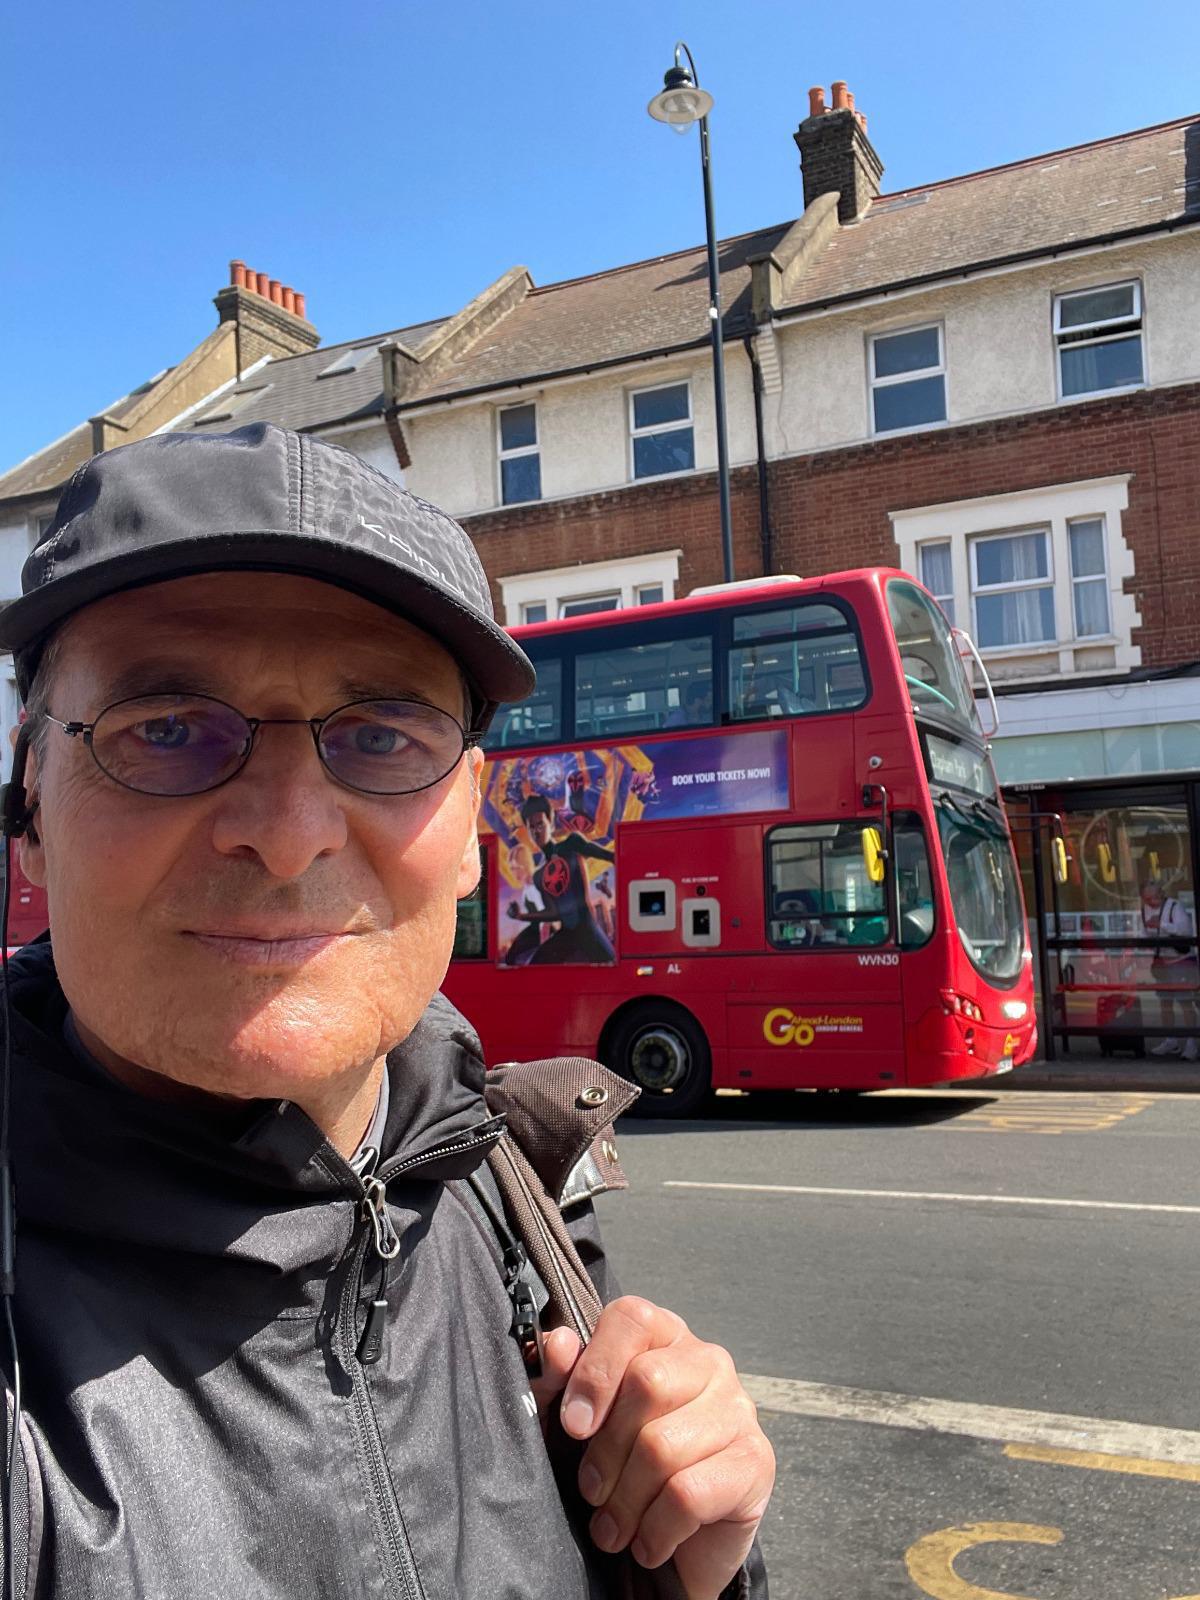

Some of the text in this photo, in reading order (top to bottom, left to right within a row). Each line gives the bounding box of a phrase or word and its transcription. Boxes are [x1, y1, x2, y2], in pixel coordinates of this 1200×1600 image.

[672, 767, 771, 786] BOOK YOUR TICKETS NOW!
[857, 953, 900, 966] WVN30
[667, 963, 682, 975] AL
[763, 1007, 815, 1047] Go
